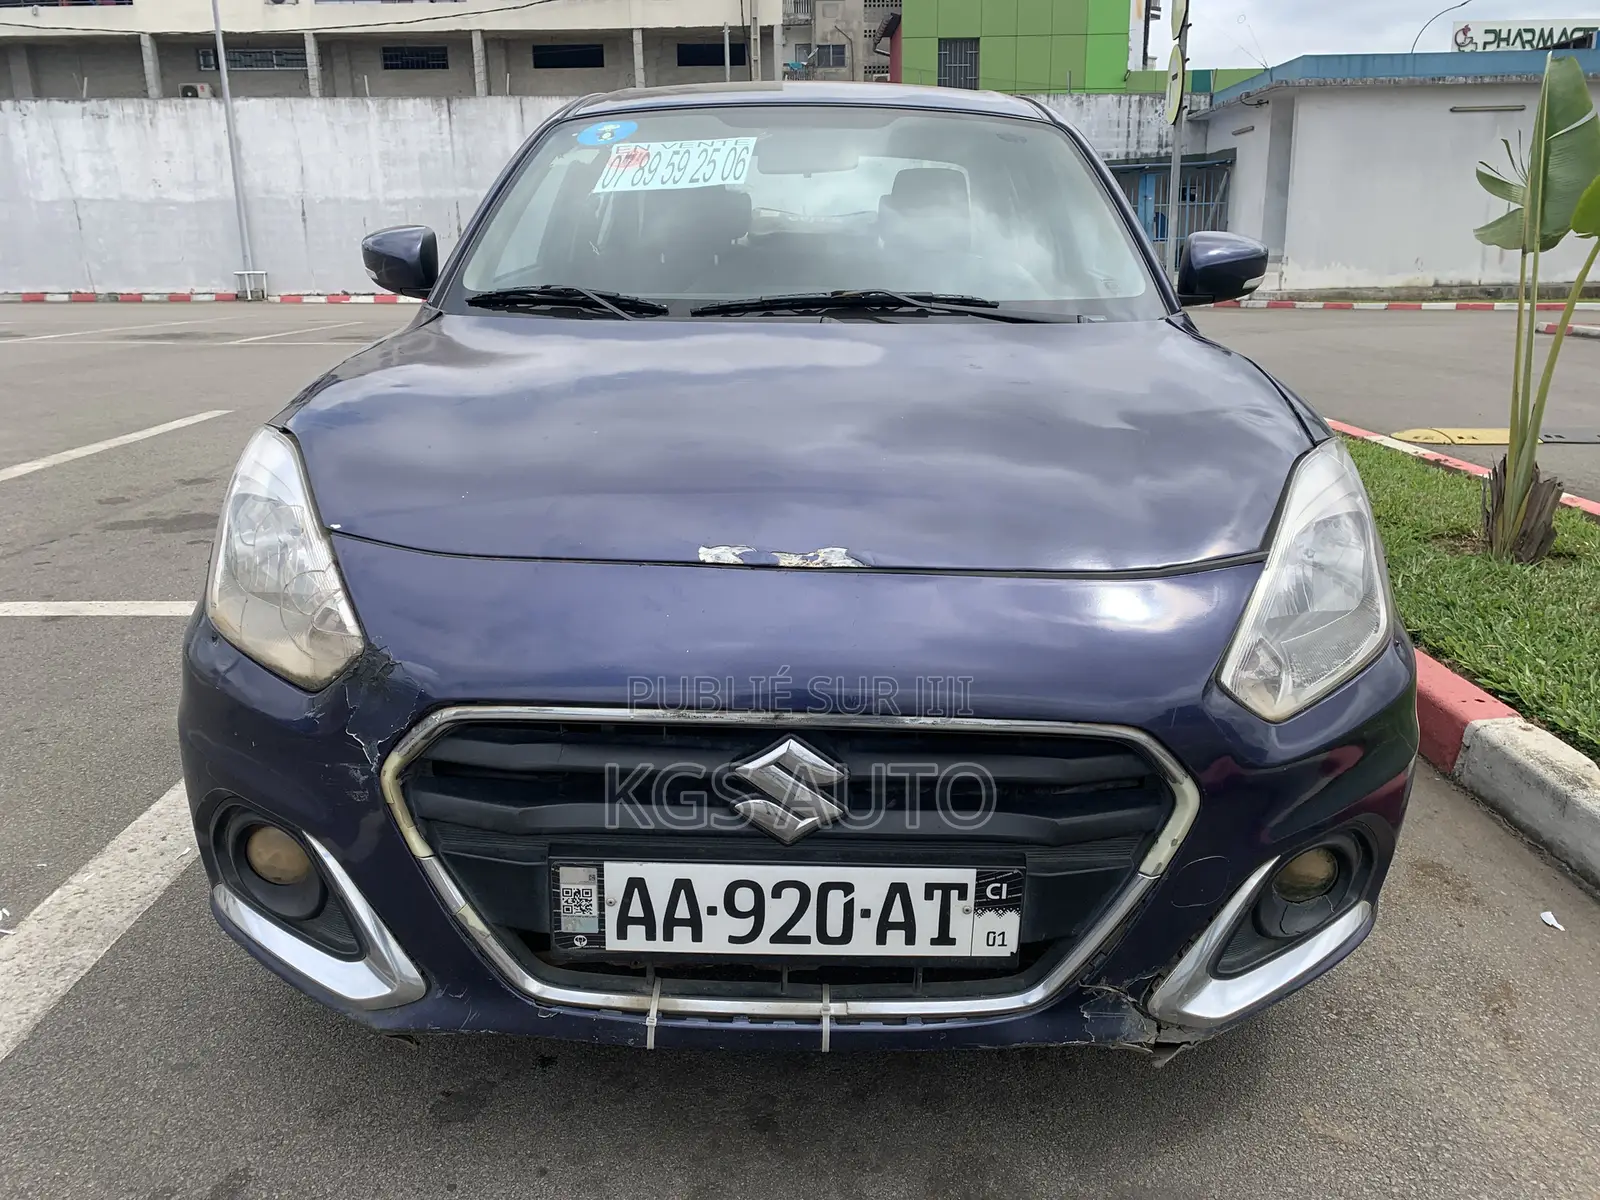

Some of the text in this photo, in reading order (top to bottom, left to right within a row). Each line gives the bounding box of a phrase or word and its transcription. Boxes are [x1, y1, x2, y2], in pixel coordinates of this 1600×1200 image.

[1483, 26, 1599, 49] PHARMAC
[616, 140, 750, 154] EN VENTE
[631, 151, 662, 187] 89
[661, 149, 691, 185] 59
[689, 148, 721, 183] 25
[721, 146, 749, 181] 06
[986, 883, 1008, 900] CI
[985, 931, 1008, 947] 01
